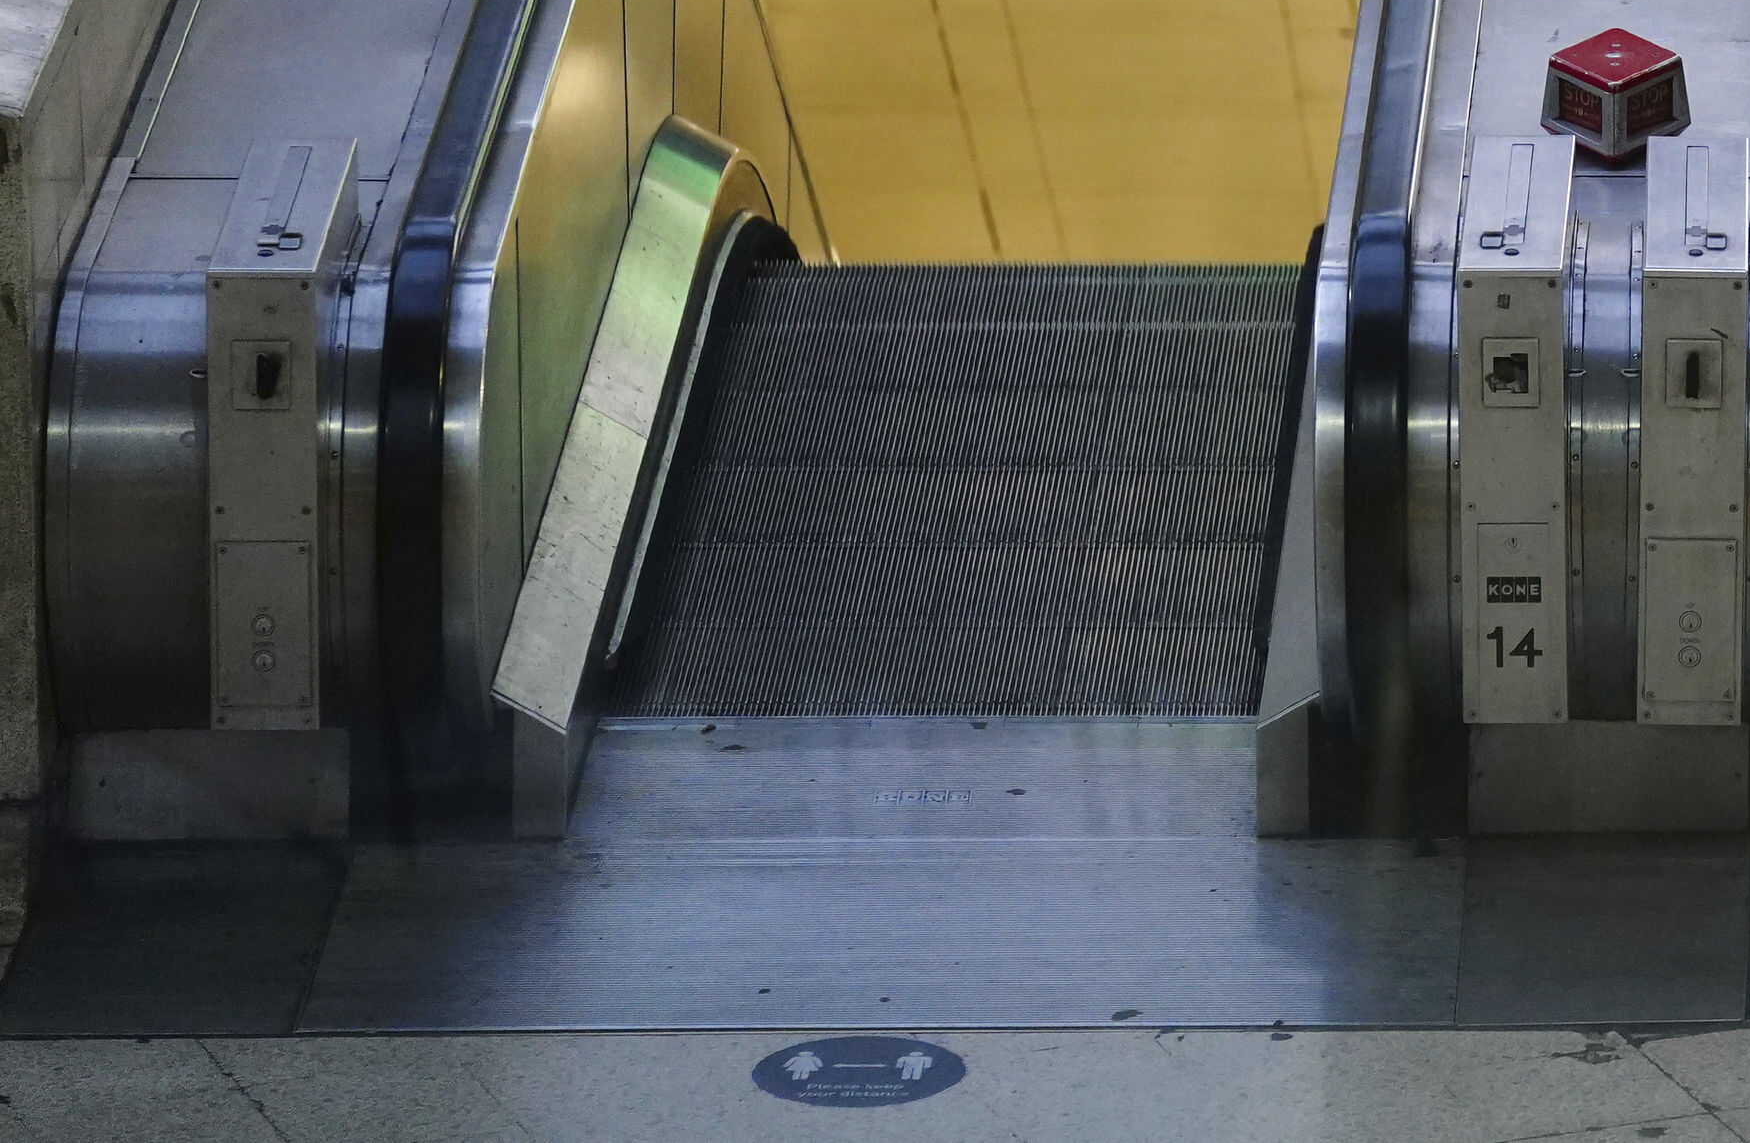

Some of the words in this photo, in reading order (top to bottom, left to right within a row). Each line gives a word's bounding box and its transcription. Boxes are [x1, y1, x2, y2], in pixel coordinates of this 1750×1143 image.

[1564, 82, 1600, 108] STOP
[1631, 83, 1669, 110] STOP
[1487, 582, 1541, 598] KONE
[1486, 625, 1544, 669] 14
